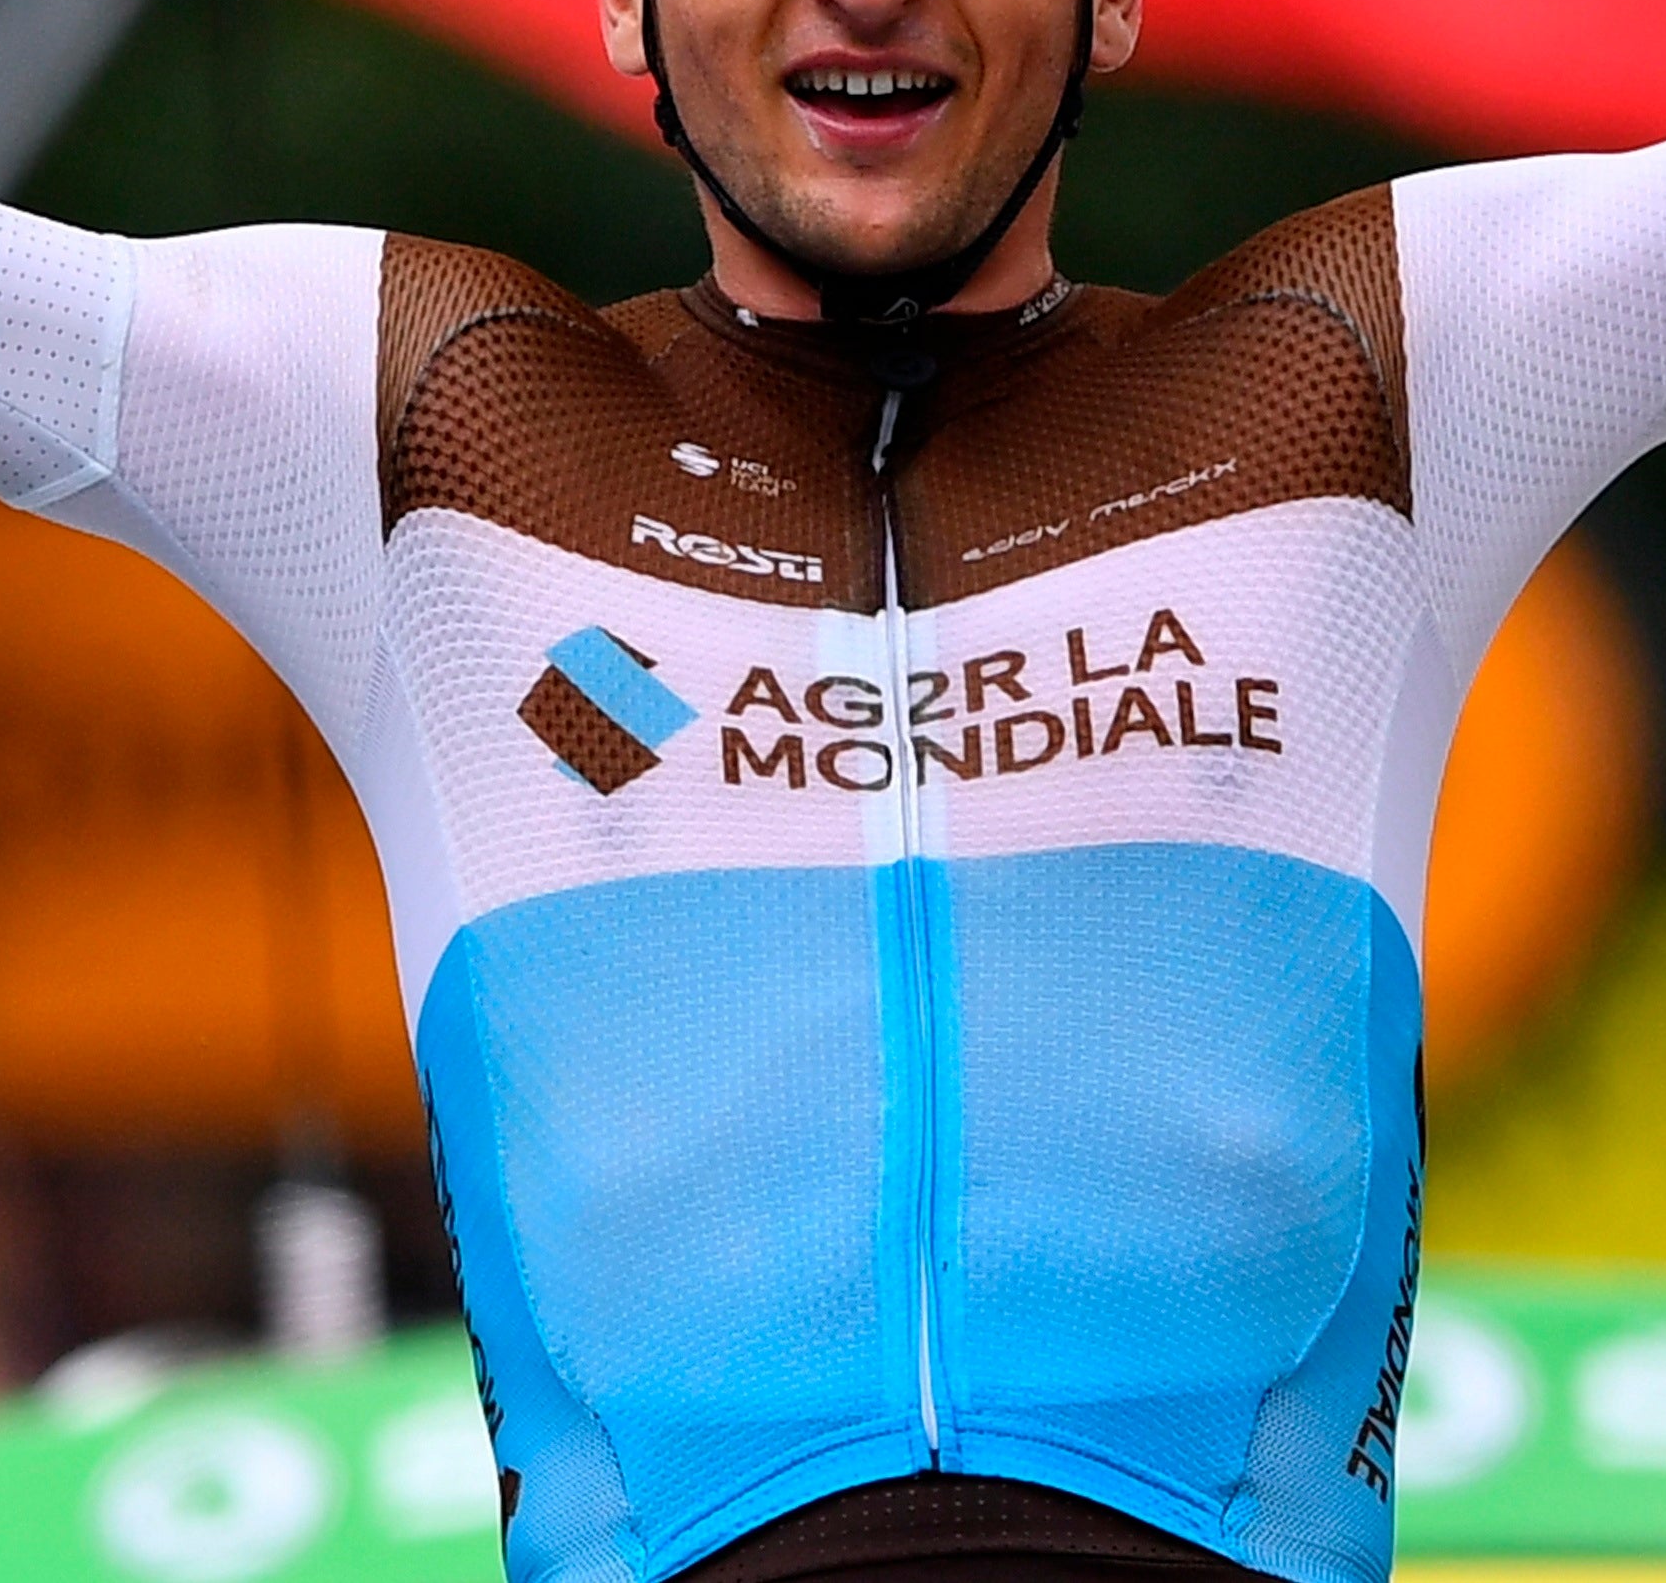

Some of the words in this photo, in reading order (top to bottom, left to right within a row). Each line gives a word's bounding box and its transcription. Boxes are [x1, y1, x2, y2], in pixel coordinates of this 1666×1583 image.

[731, 457, 768, 475] UCI
[1088, 457, 1237, 521] merckx
[724, 649, 1032, 729] AG2R
[1065, 608, 1206, 686] LA
[719, 677, 1284, 792] MONDIALE
